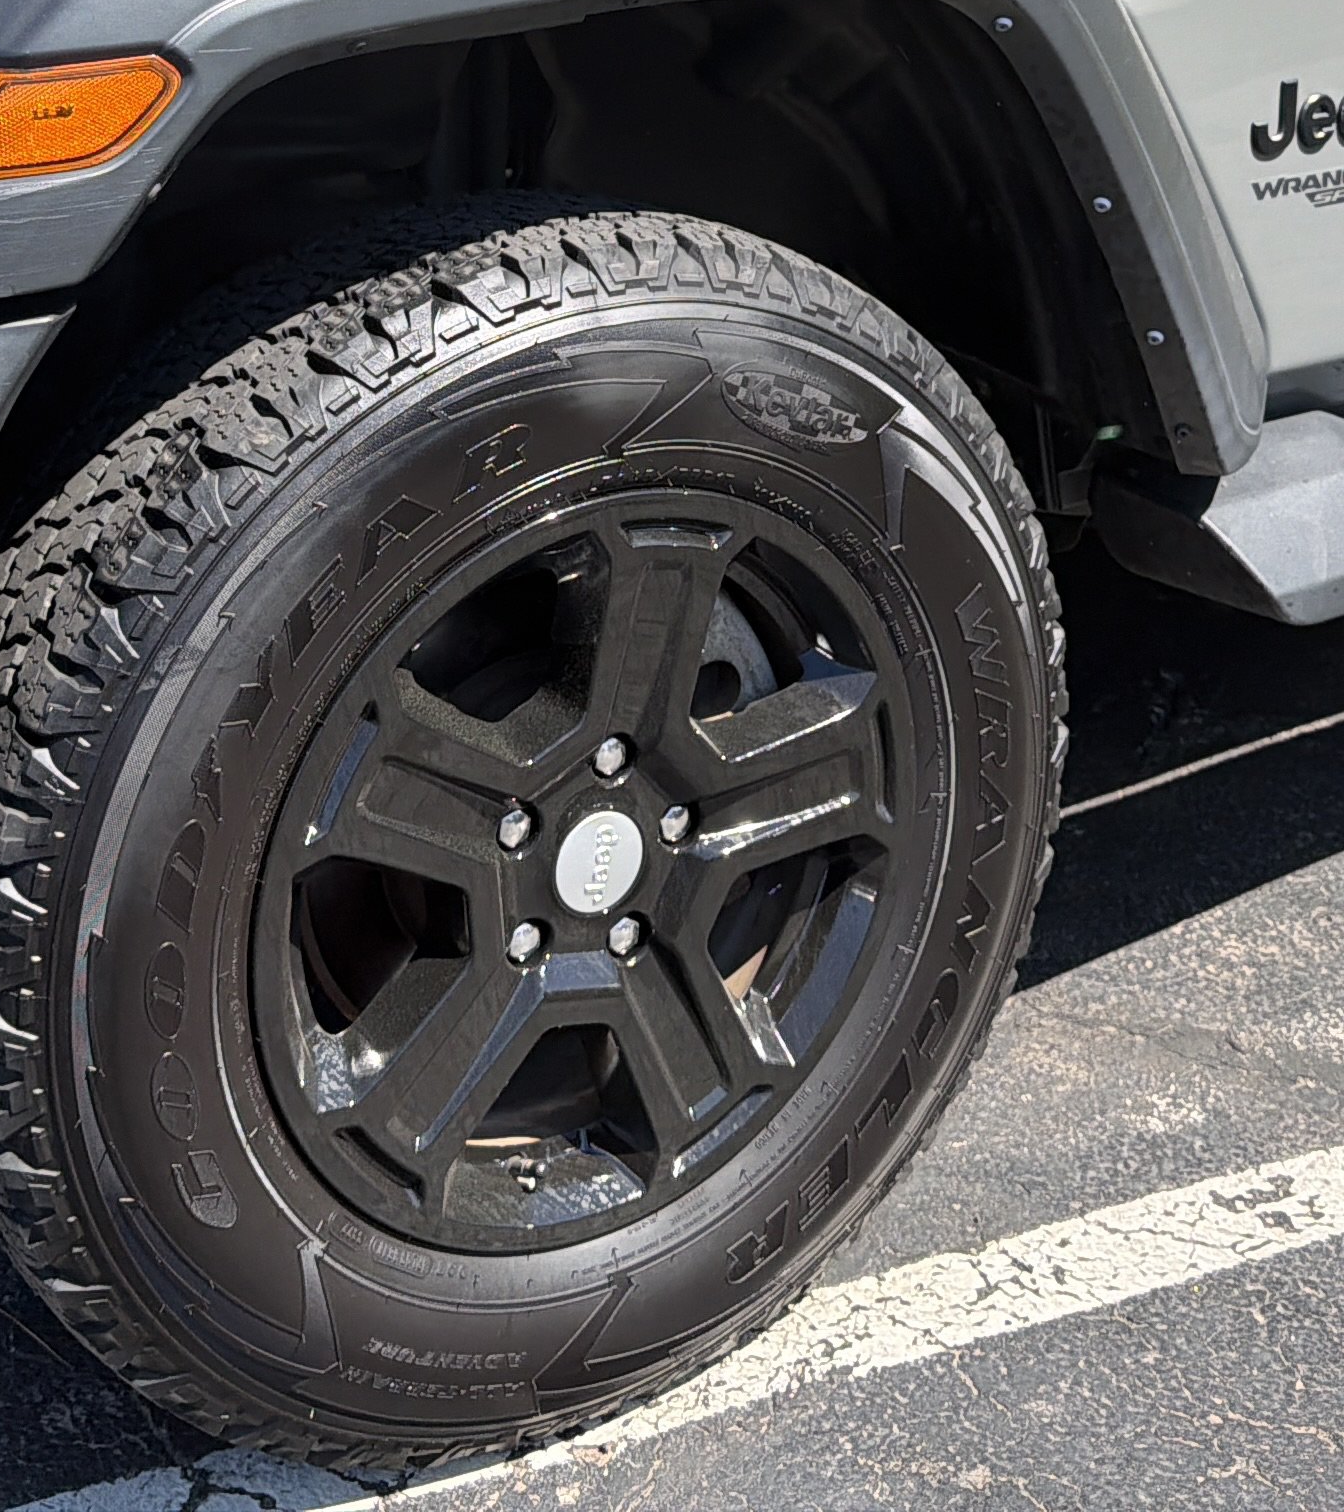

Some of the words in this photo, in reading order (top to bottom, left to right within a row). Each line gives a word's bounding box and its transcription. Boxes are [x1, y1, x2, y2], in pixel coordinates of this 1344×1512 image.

[740, 373, 856, 440] Kevlar
[145, 422, 534, 1229] GOODYEAR
[580, 819, 620, 903] Jeep
[725, 582, 1014, 1286] WRANGLER
[340, 1362, 526, 1403] ALL-TERRAIN
[361, 1336, 528, 1369] ADVENTURE
